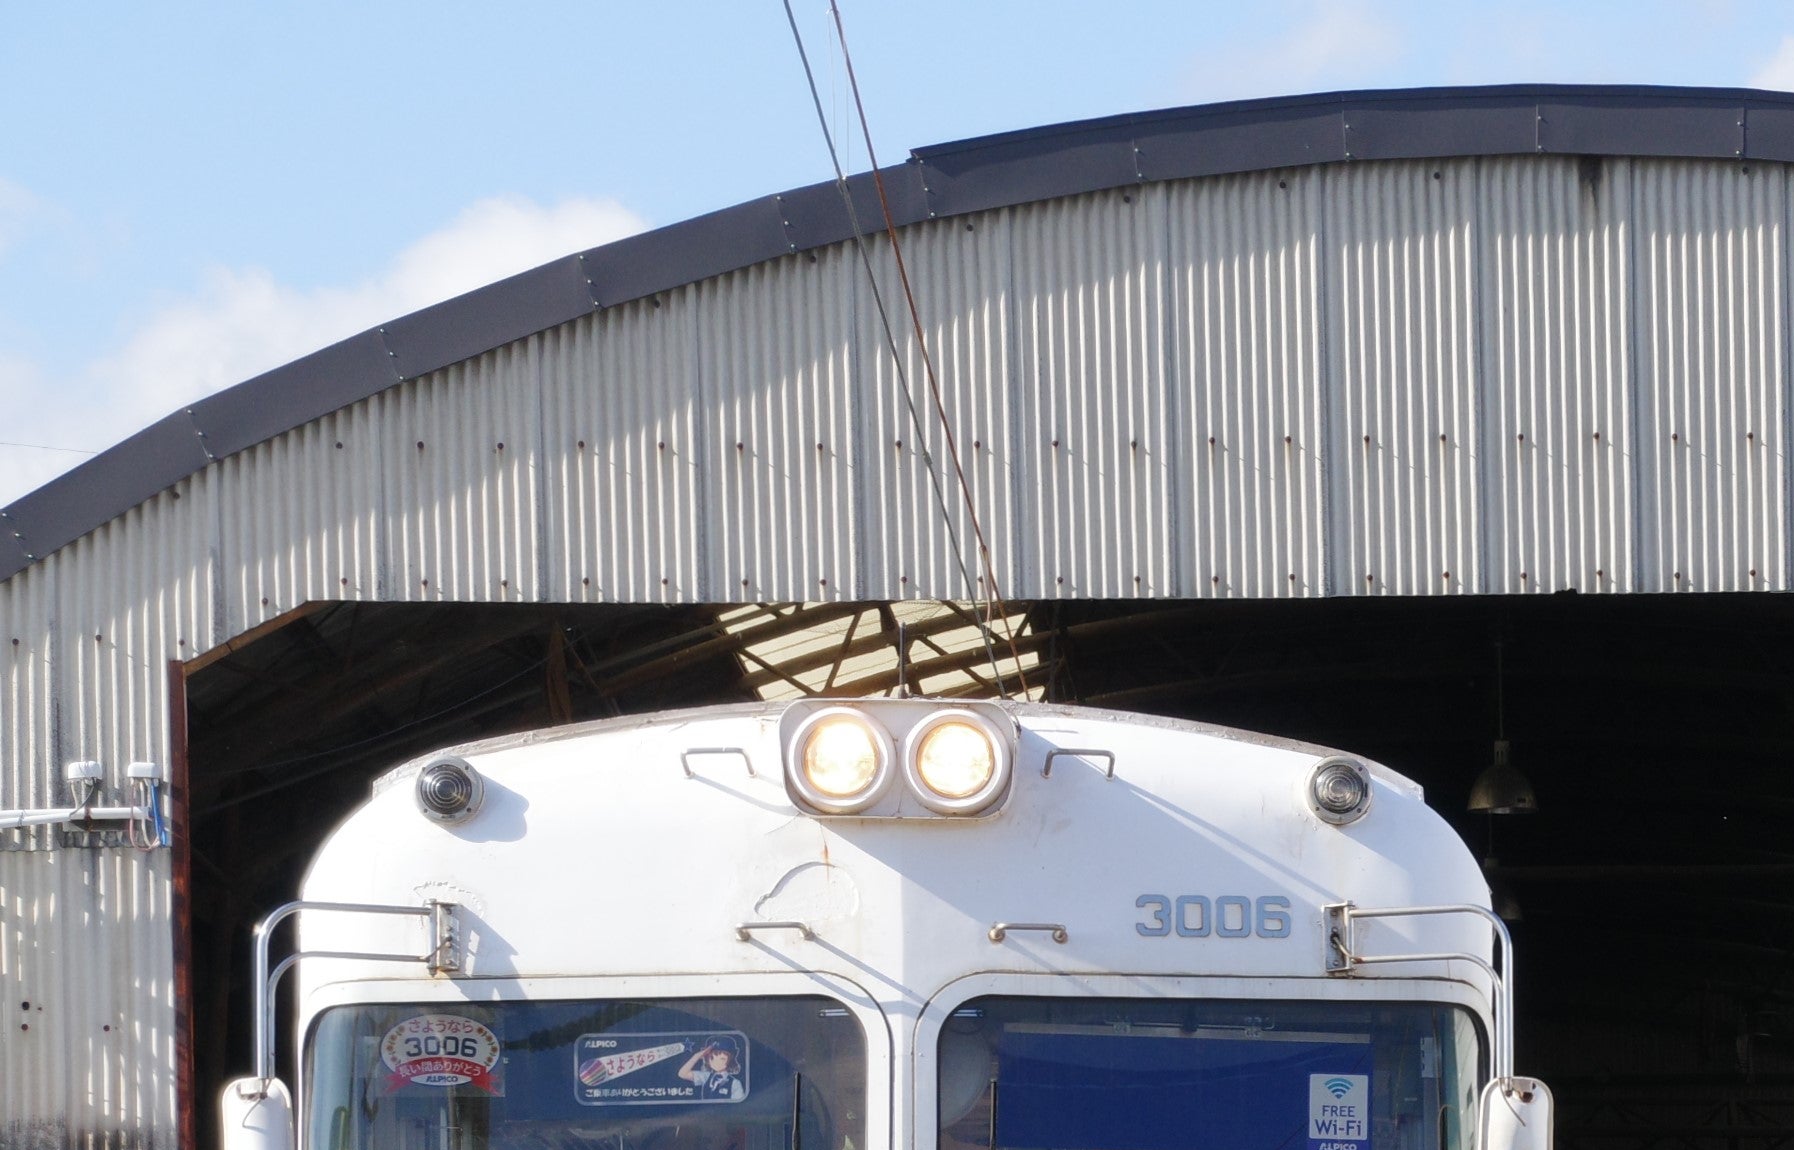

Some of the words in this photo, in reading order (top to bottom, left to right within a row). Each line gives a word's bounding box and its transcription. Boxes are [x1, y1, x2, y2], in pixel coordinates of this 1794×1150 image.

[1135, 894, 1292, 938] 3006
[408, 1020, 474, 1034] さようなら
[404, 1036, 478, 1057] 3006
[584, 1040, 618, 1049] ALPICO
[399, 1060, 482, 1077] 長い間ありがとう
[606, 1050, 655, 1076] さようなら
[1321, 1105, 1356, 1117] FREE
[1314, 1119, 1362, 1136] Wi-Fi
